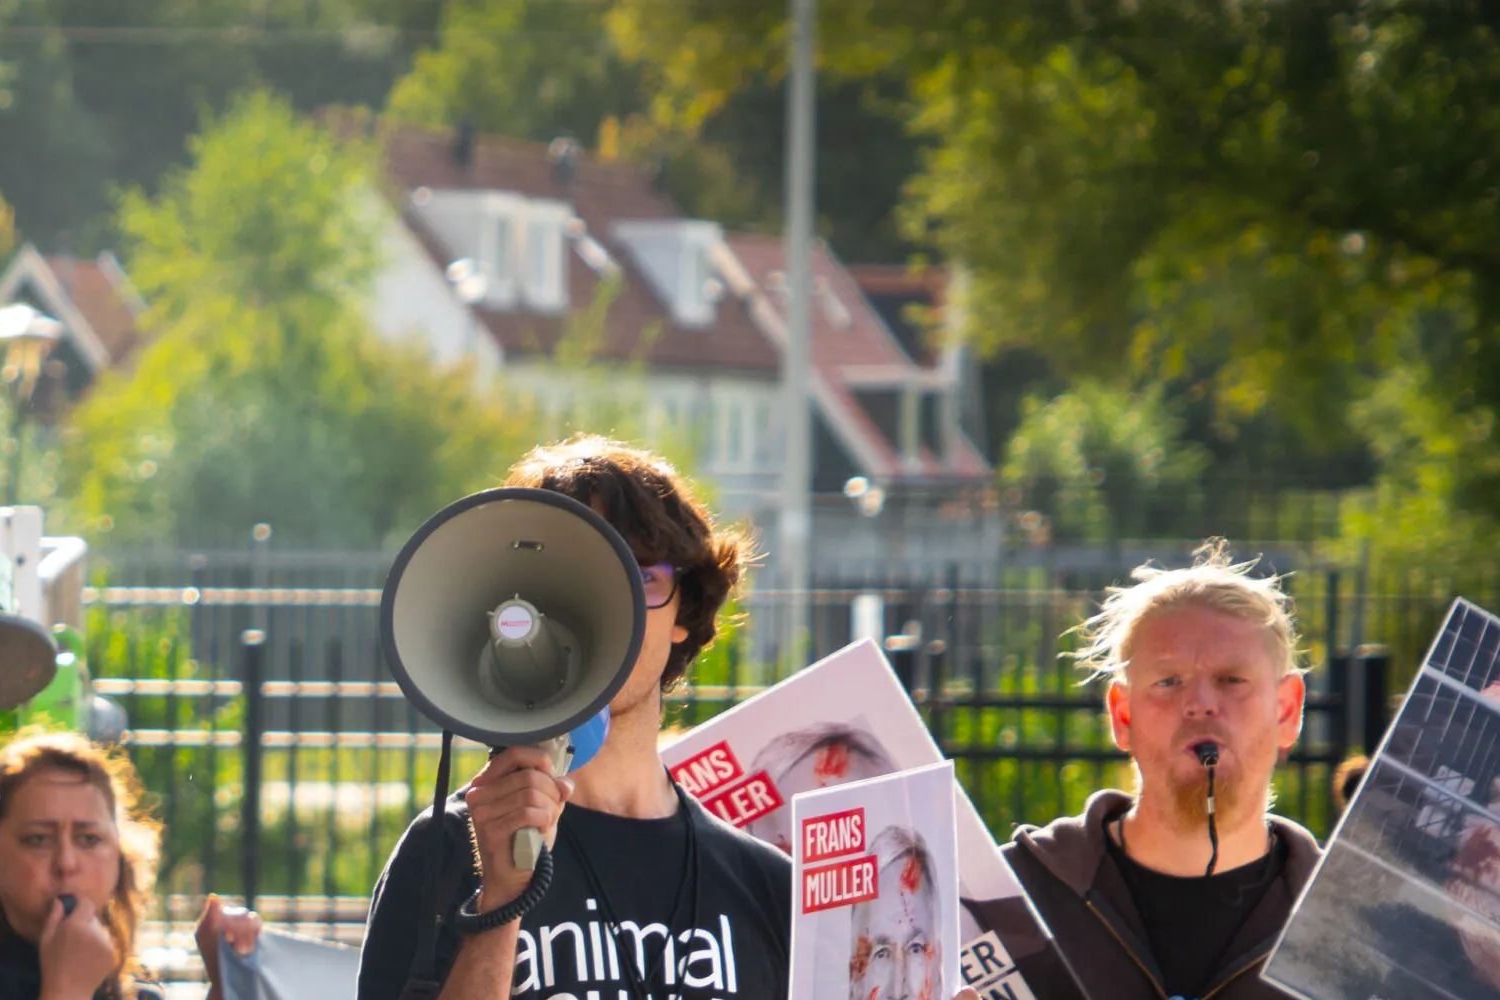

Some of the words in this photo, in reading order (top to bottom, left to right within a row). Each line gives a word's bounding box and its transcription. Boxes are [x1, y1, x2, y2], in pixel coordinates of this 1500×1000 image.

[806, 815, 863, 858] FRANS
[806, 863, 874, 907] MULLER
[511, 898, 738, 996] animal
